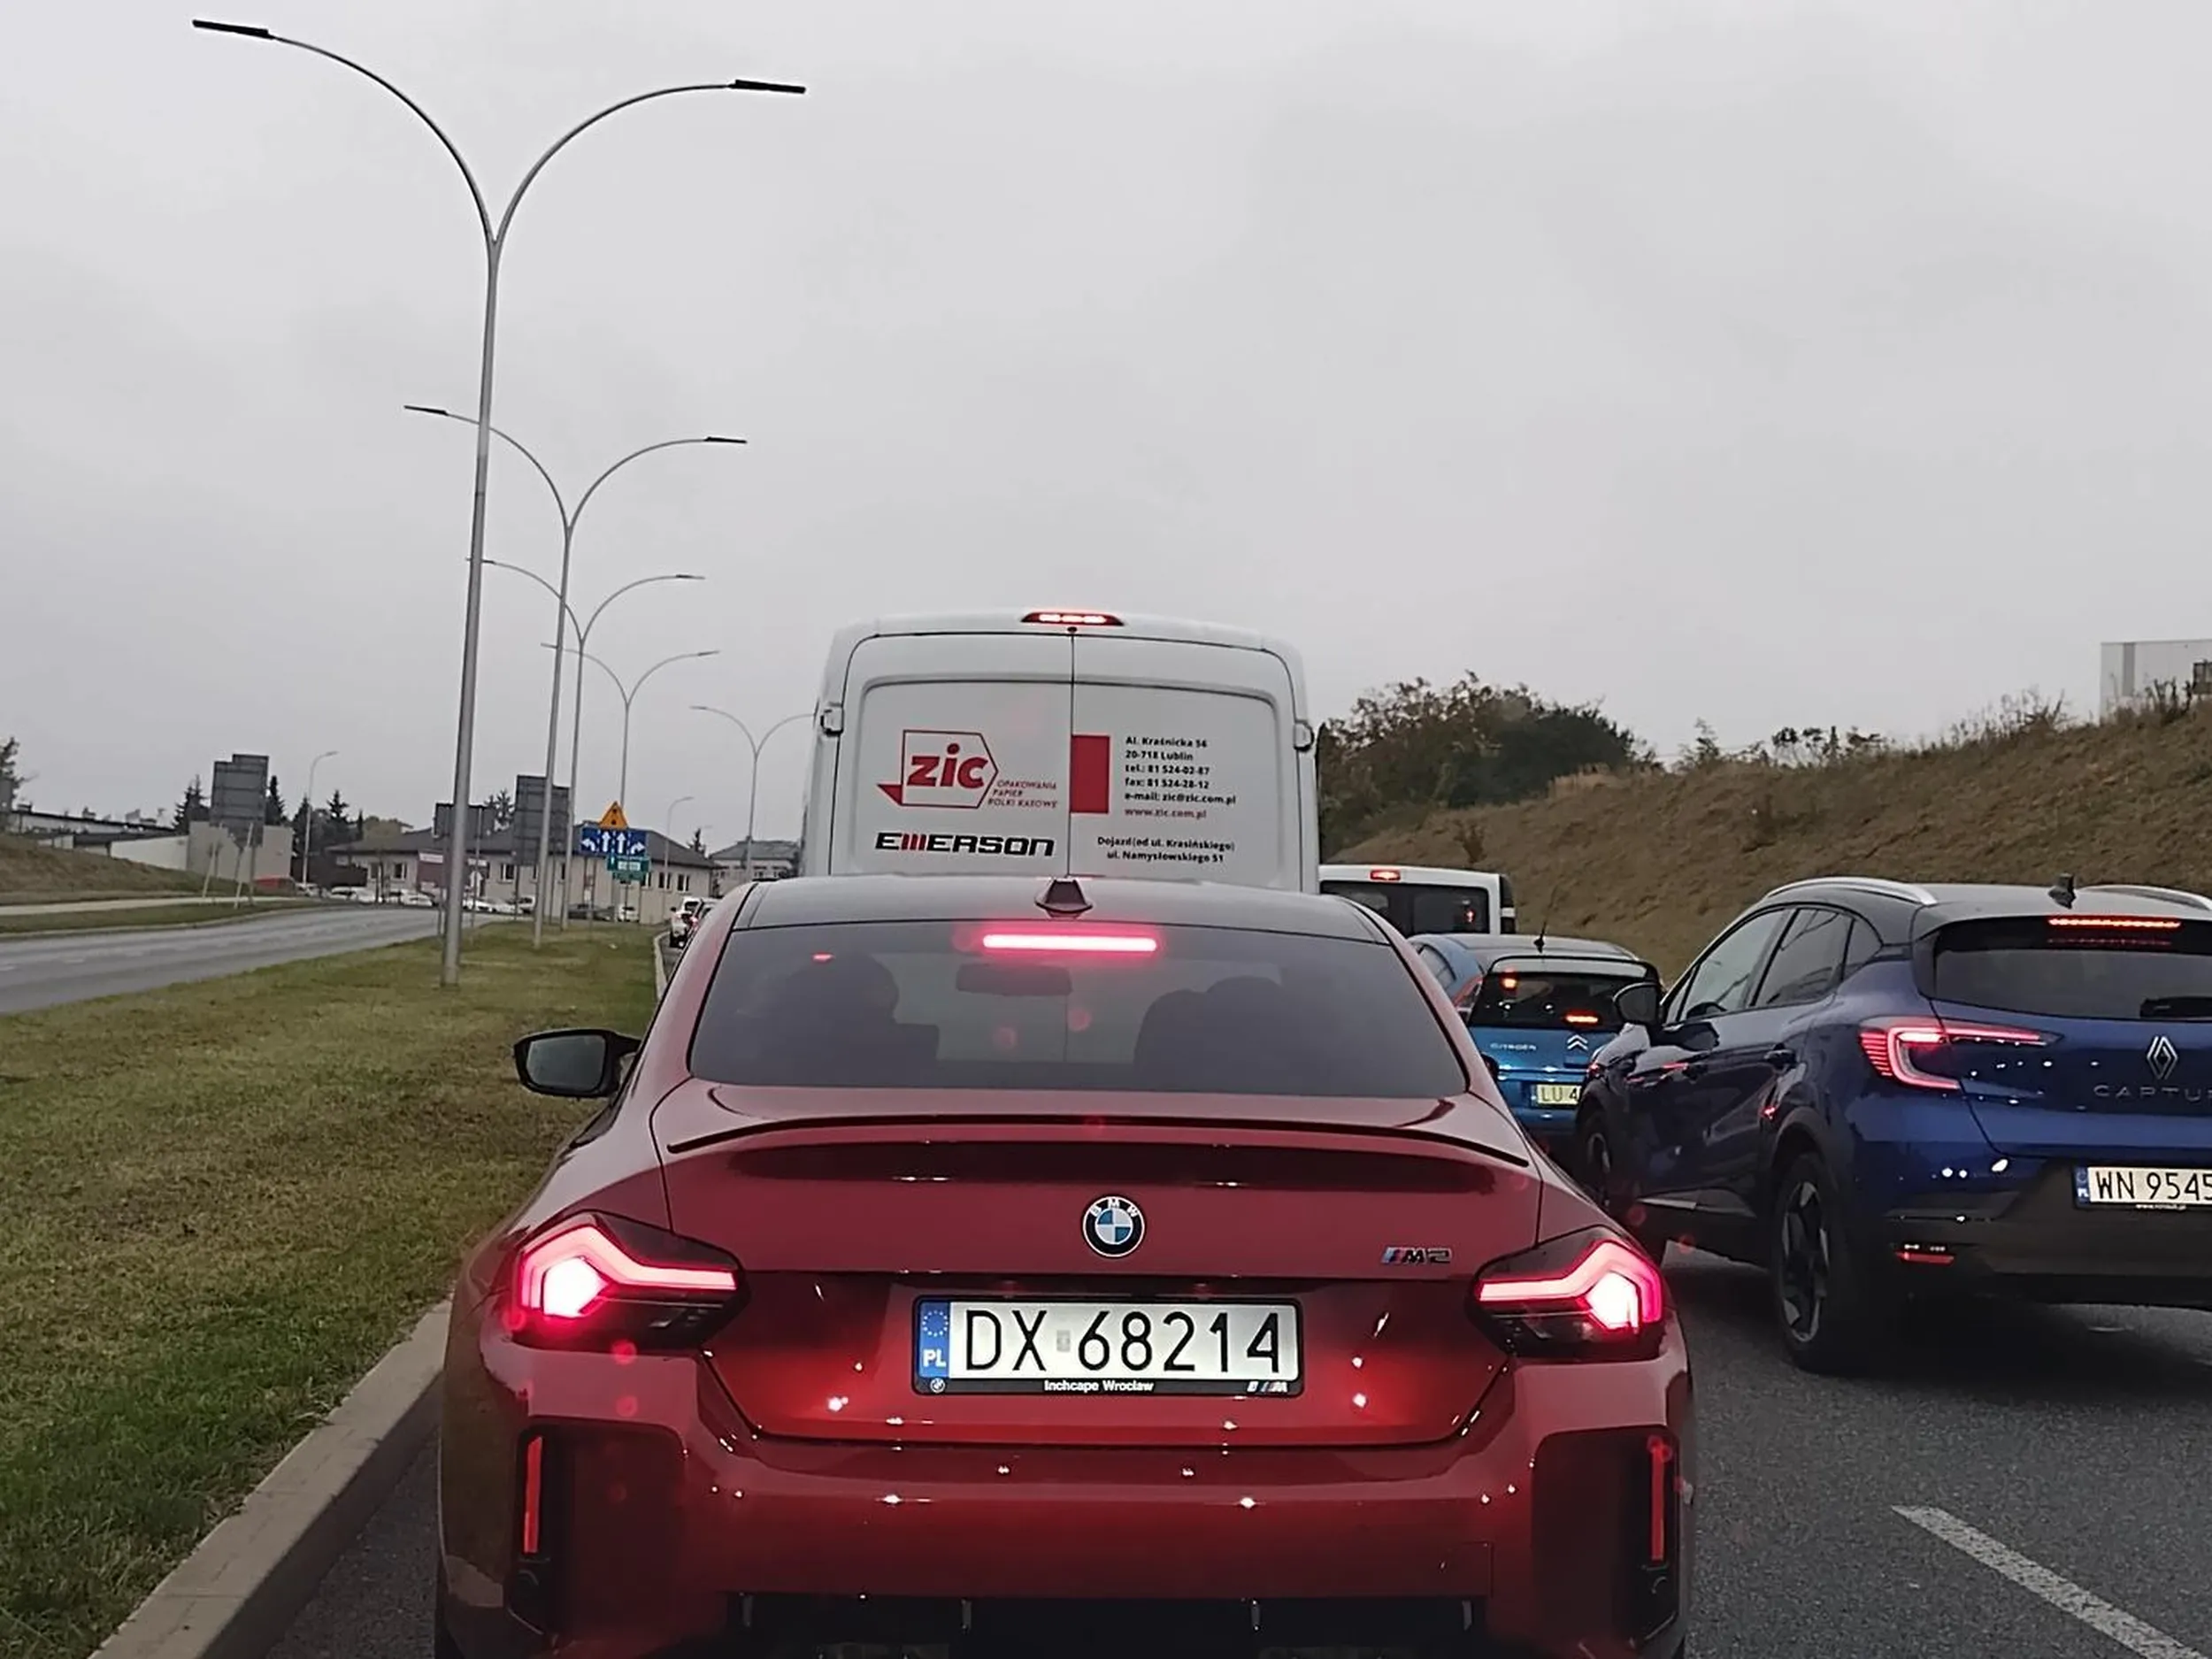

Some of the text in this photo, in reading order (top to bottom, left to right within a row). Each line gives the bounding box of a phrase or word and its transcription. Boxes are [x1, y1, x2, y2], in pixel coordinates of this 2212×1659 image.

[1125, 749, 1194, 761] 20-718 Lublin
[906, 743, 989, 789] zic
[1148, 764, 1159, 773] 81
[1125, 777, 1210, 790] fax: 81 524-28-12
[1125, 791, 1236, 806] e-mail: zic@zic.com.pl
[1125, 807, 1207, 820] www.zic.com.pl
[1212, 853, 1224, 863] 51
[1541, 1087, 1563, 1102] LU
[2095, 1171, 2135, 1200] WN
[965, 1310, 1279, 1373] DX 68214
[922, 1348, 948, 1368] PL
[1044, 1379, 1100, 1394] Inchcape
